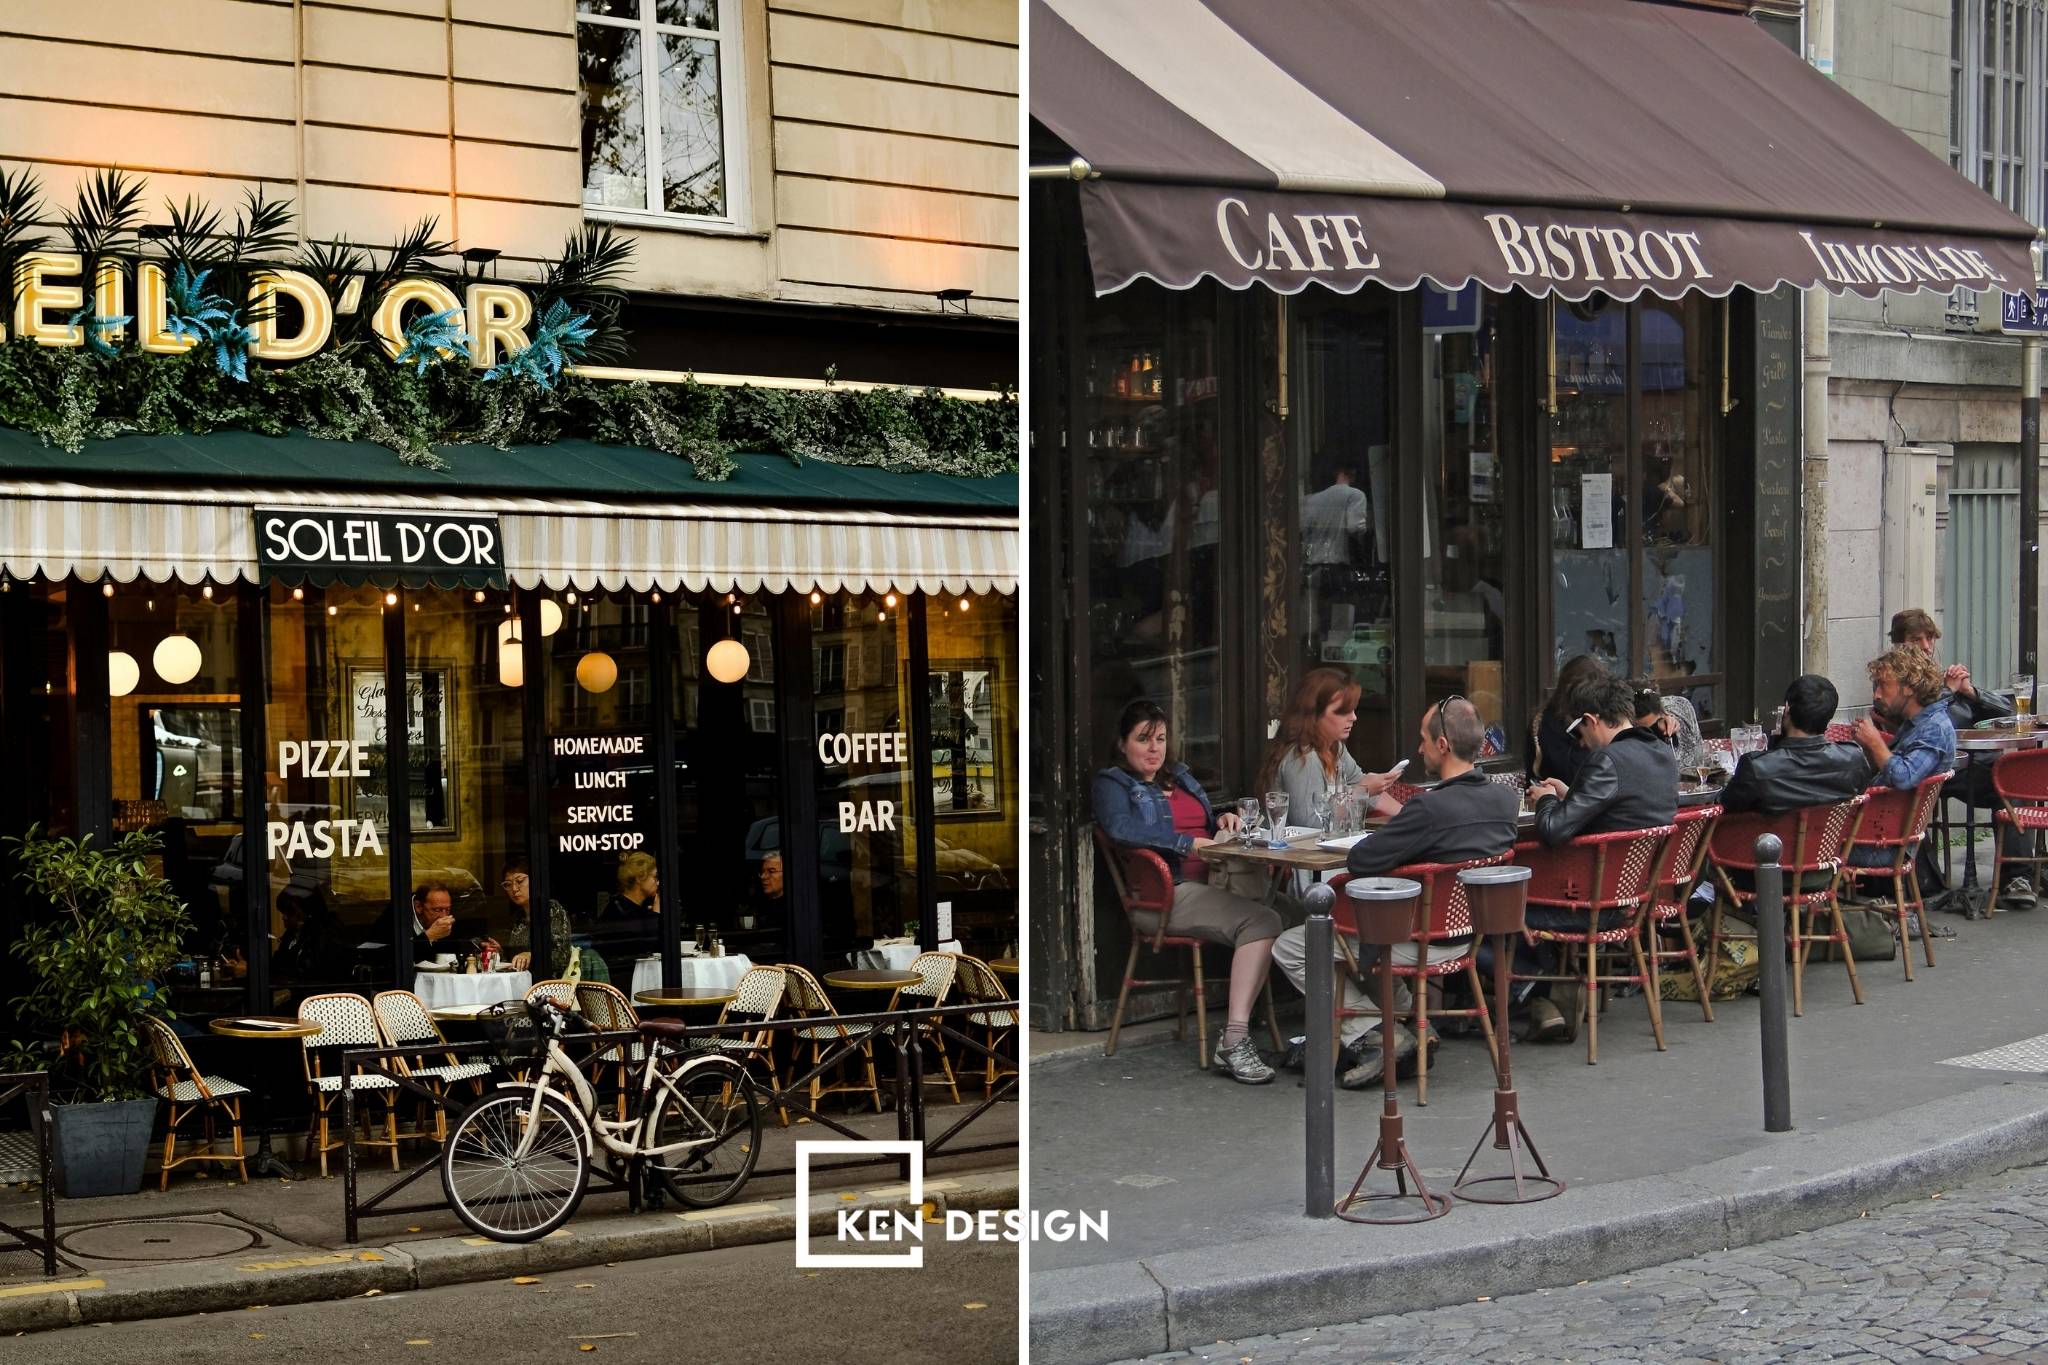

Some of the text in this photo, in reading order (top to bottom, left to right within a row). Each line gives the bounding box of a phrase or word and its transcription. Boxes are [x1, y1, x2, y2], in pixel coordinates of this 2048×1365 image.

[1216, 197, 2008, 284] CAFE BISTROT LIMONADE
[0, 251, 533, 370] EIL D'OR
[265, 518, 496, 565] SOLEIL D'OR
[279, 739, 371, 779] PIZZE
[554, 736, 644, 755] HOMEMADE
[818, 732, 908, 764] COFFEE
[574, 770, 627, 789] LUNCH
[567, 804, 634, 823] SERVICE
[838, 800, 896, 833] BAR
[267, 818, 384, 860] PASTA
[559, 832, 644, 853] NON-STOP
